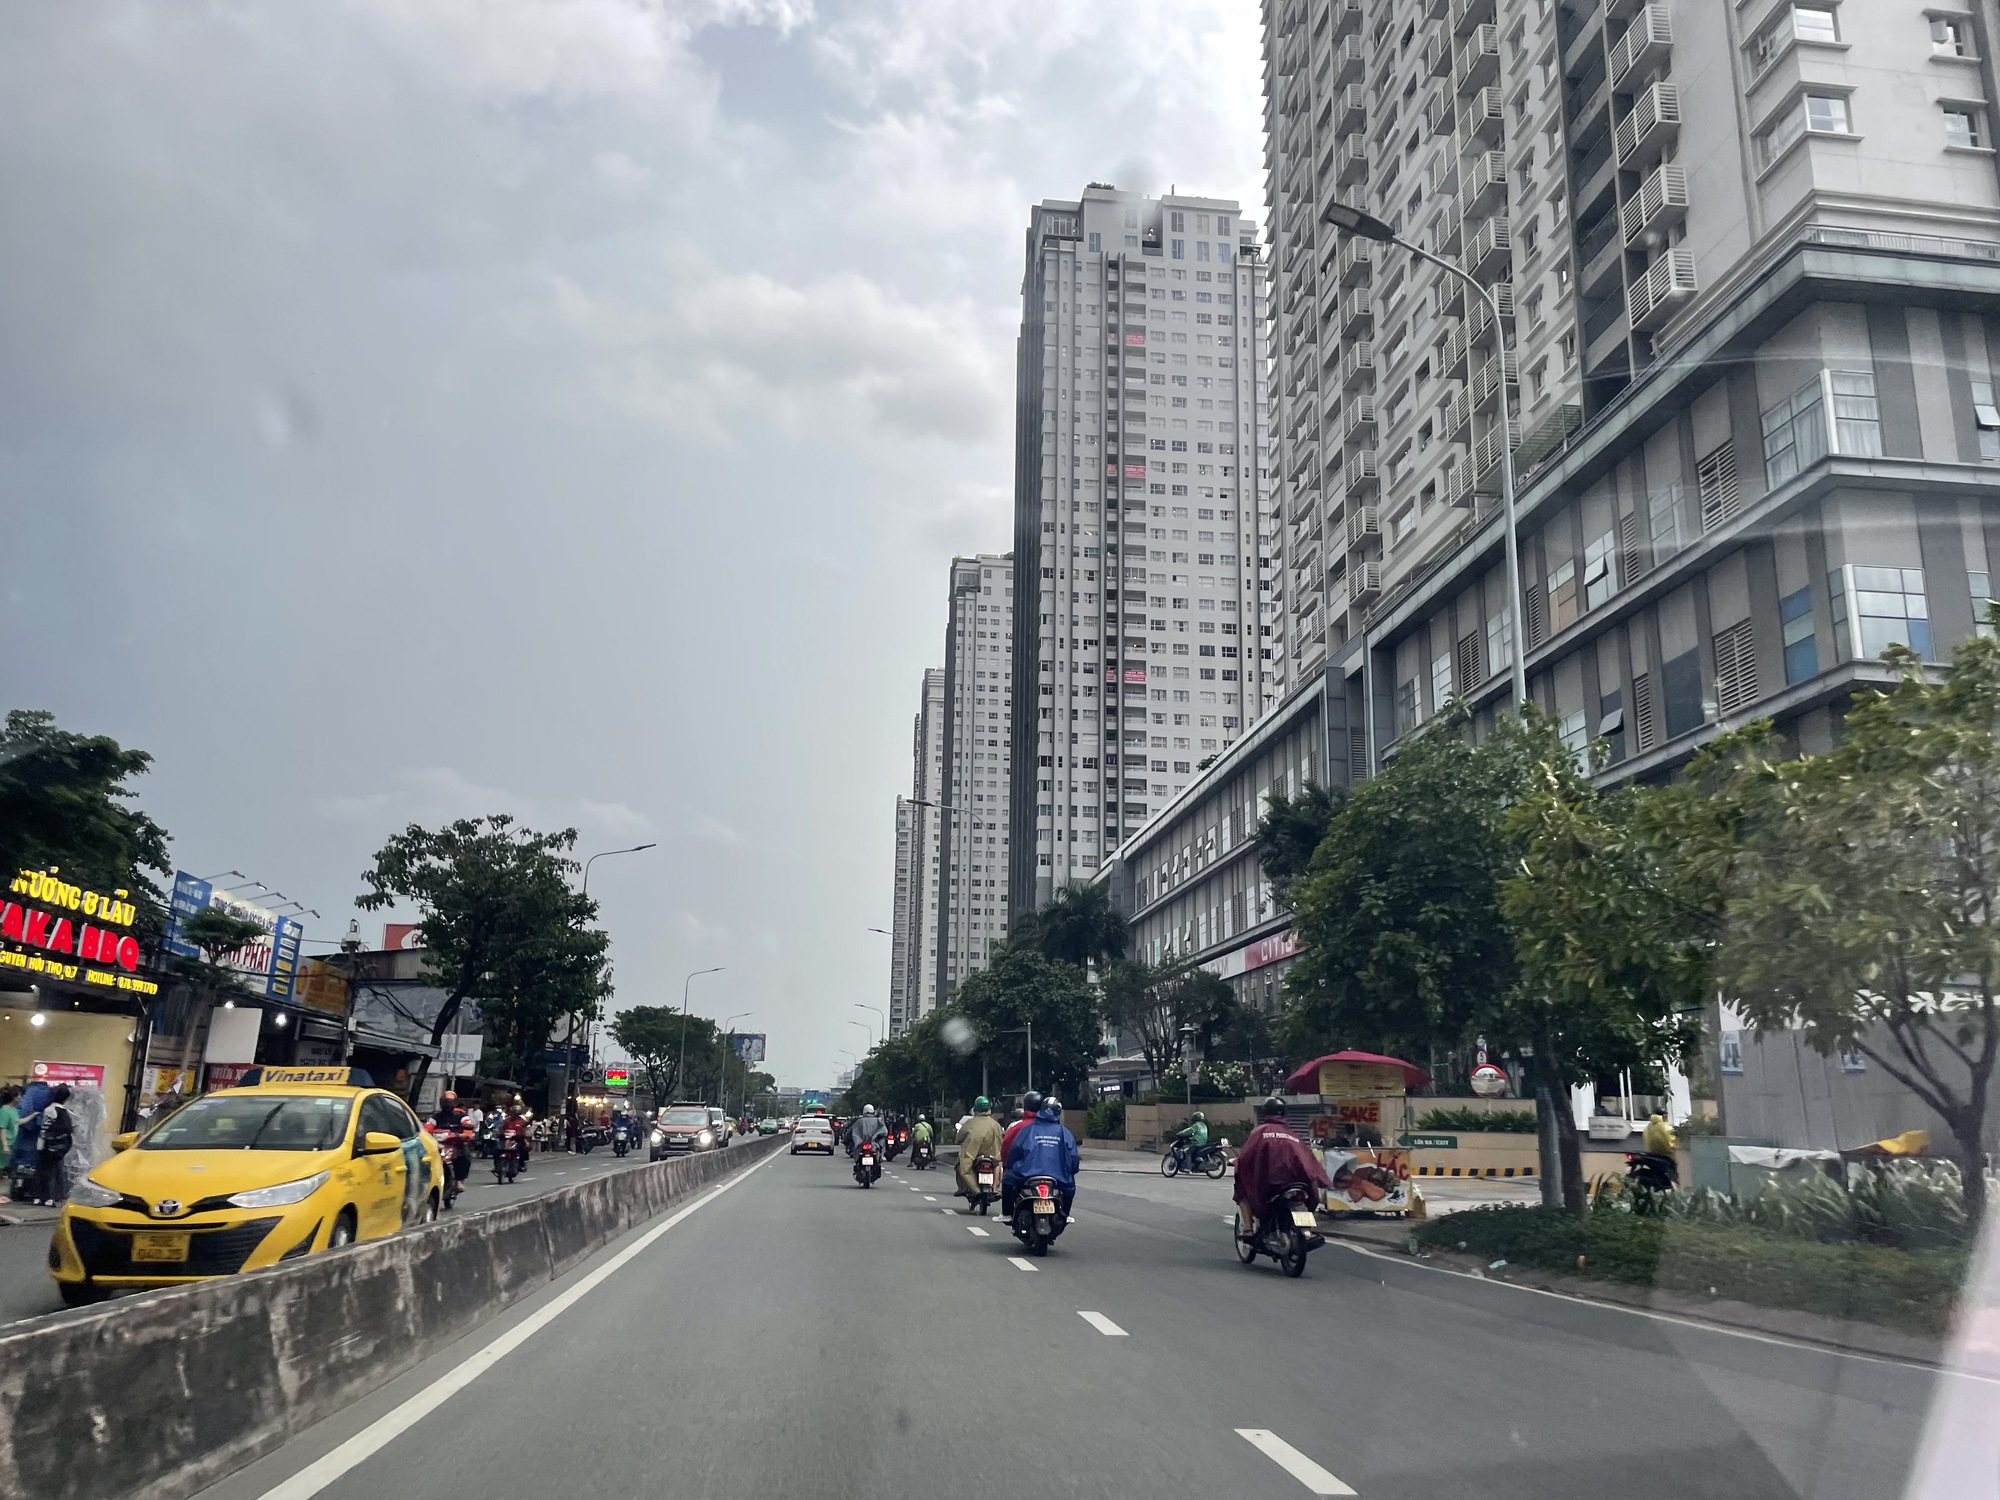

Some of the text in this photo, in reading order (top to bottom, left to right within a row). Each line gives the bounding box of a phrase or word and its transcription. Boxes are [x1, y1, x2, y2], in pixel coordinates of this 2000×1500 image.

[82, 890, 99, 915] &
[79, 924, 139, 972] BBQ
[243, 938, 271, 972] PHÁT
[265, 1069, 344, 1083] Vinataxi
